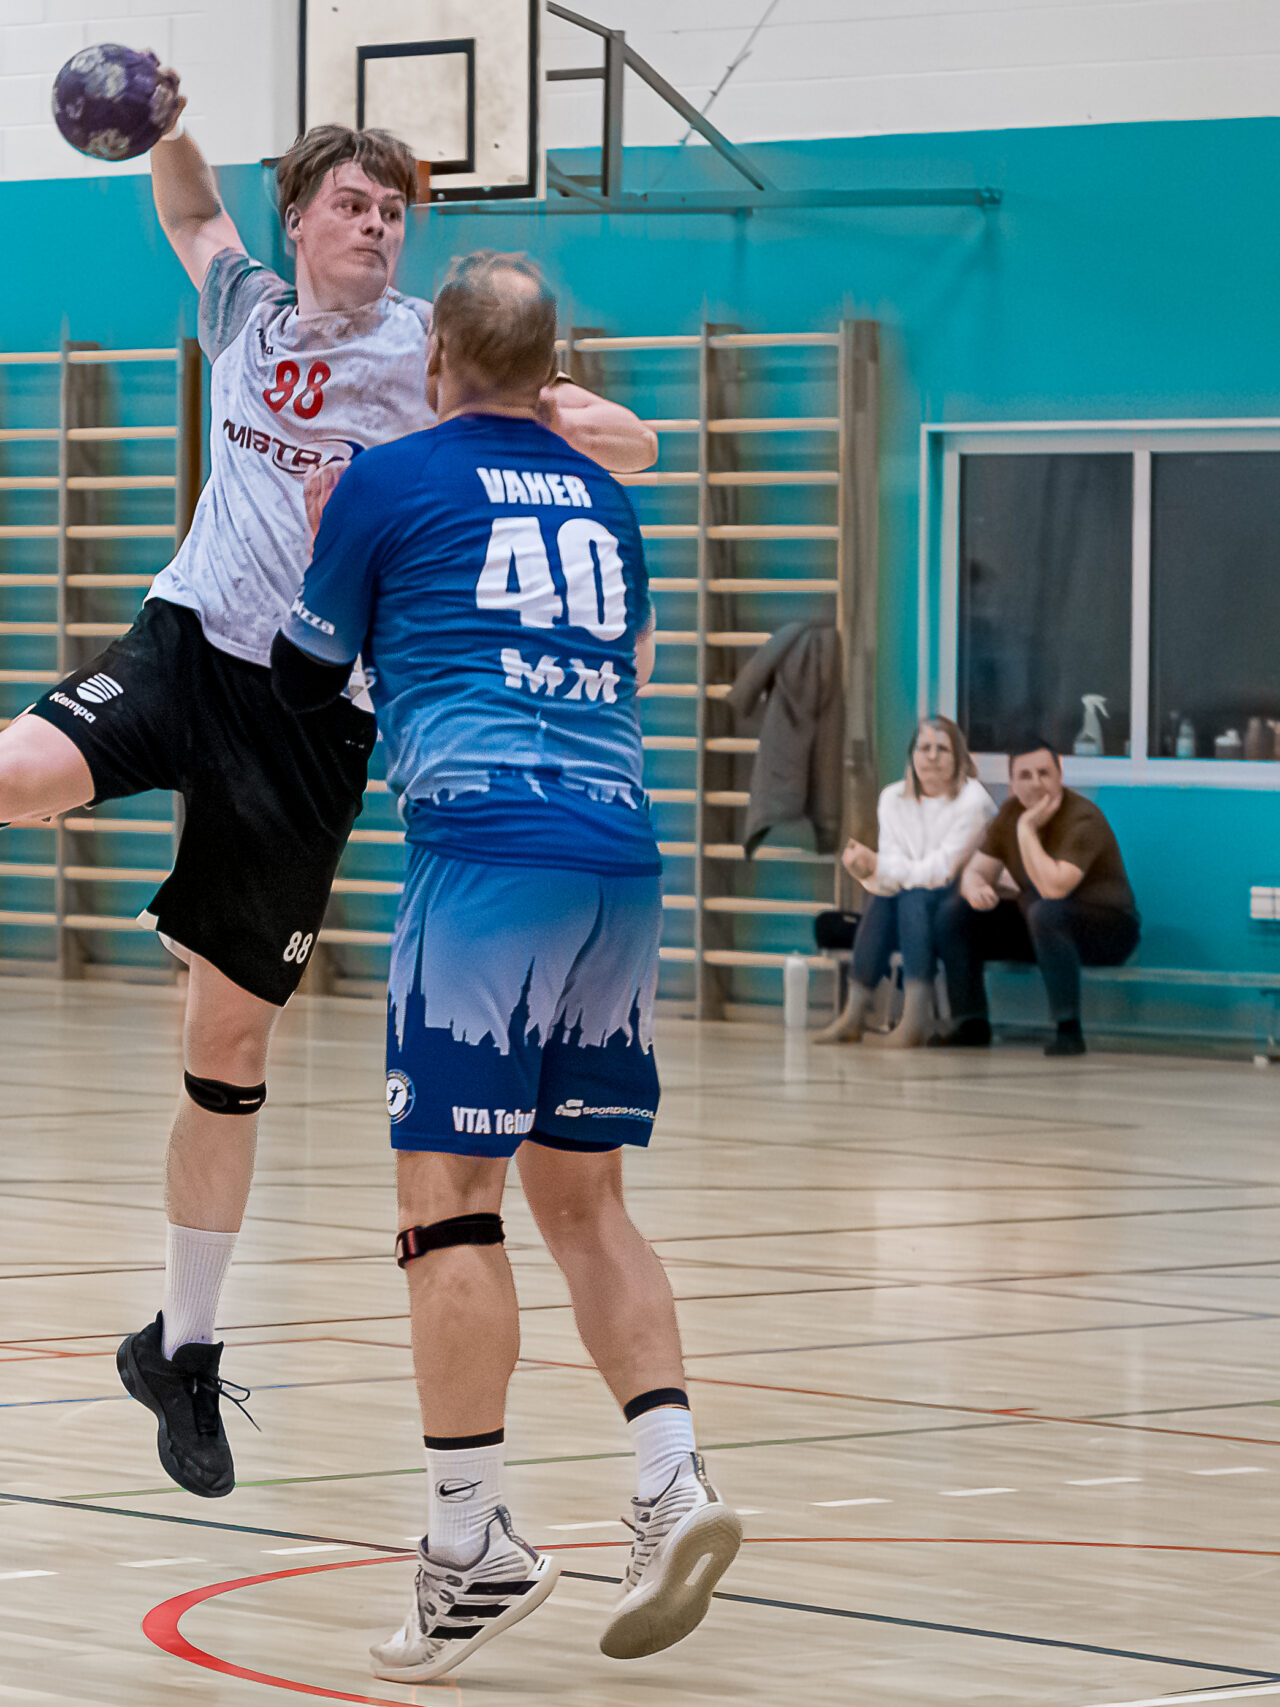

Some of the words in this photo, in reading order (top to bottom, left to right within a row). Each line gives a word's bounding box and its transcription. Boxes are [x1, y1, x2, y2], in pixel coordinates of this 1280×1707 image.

[263, 359, 331, 419] 88
[223, 418, 345, 467] MISTR
[476, 467, 592, 508] VAHER
[476, 516, 627, 642] 40
[49, 691, 97, 724] Kempa
[283, 930, 313, 964] 88
[452, 1106, 491, 1134] VTA
